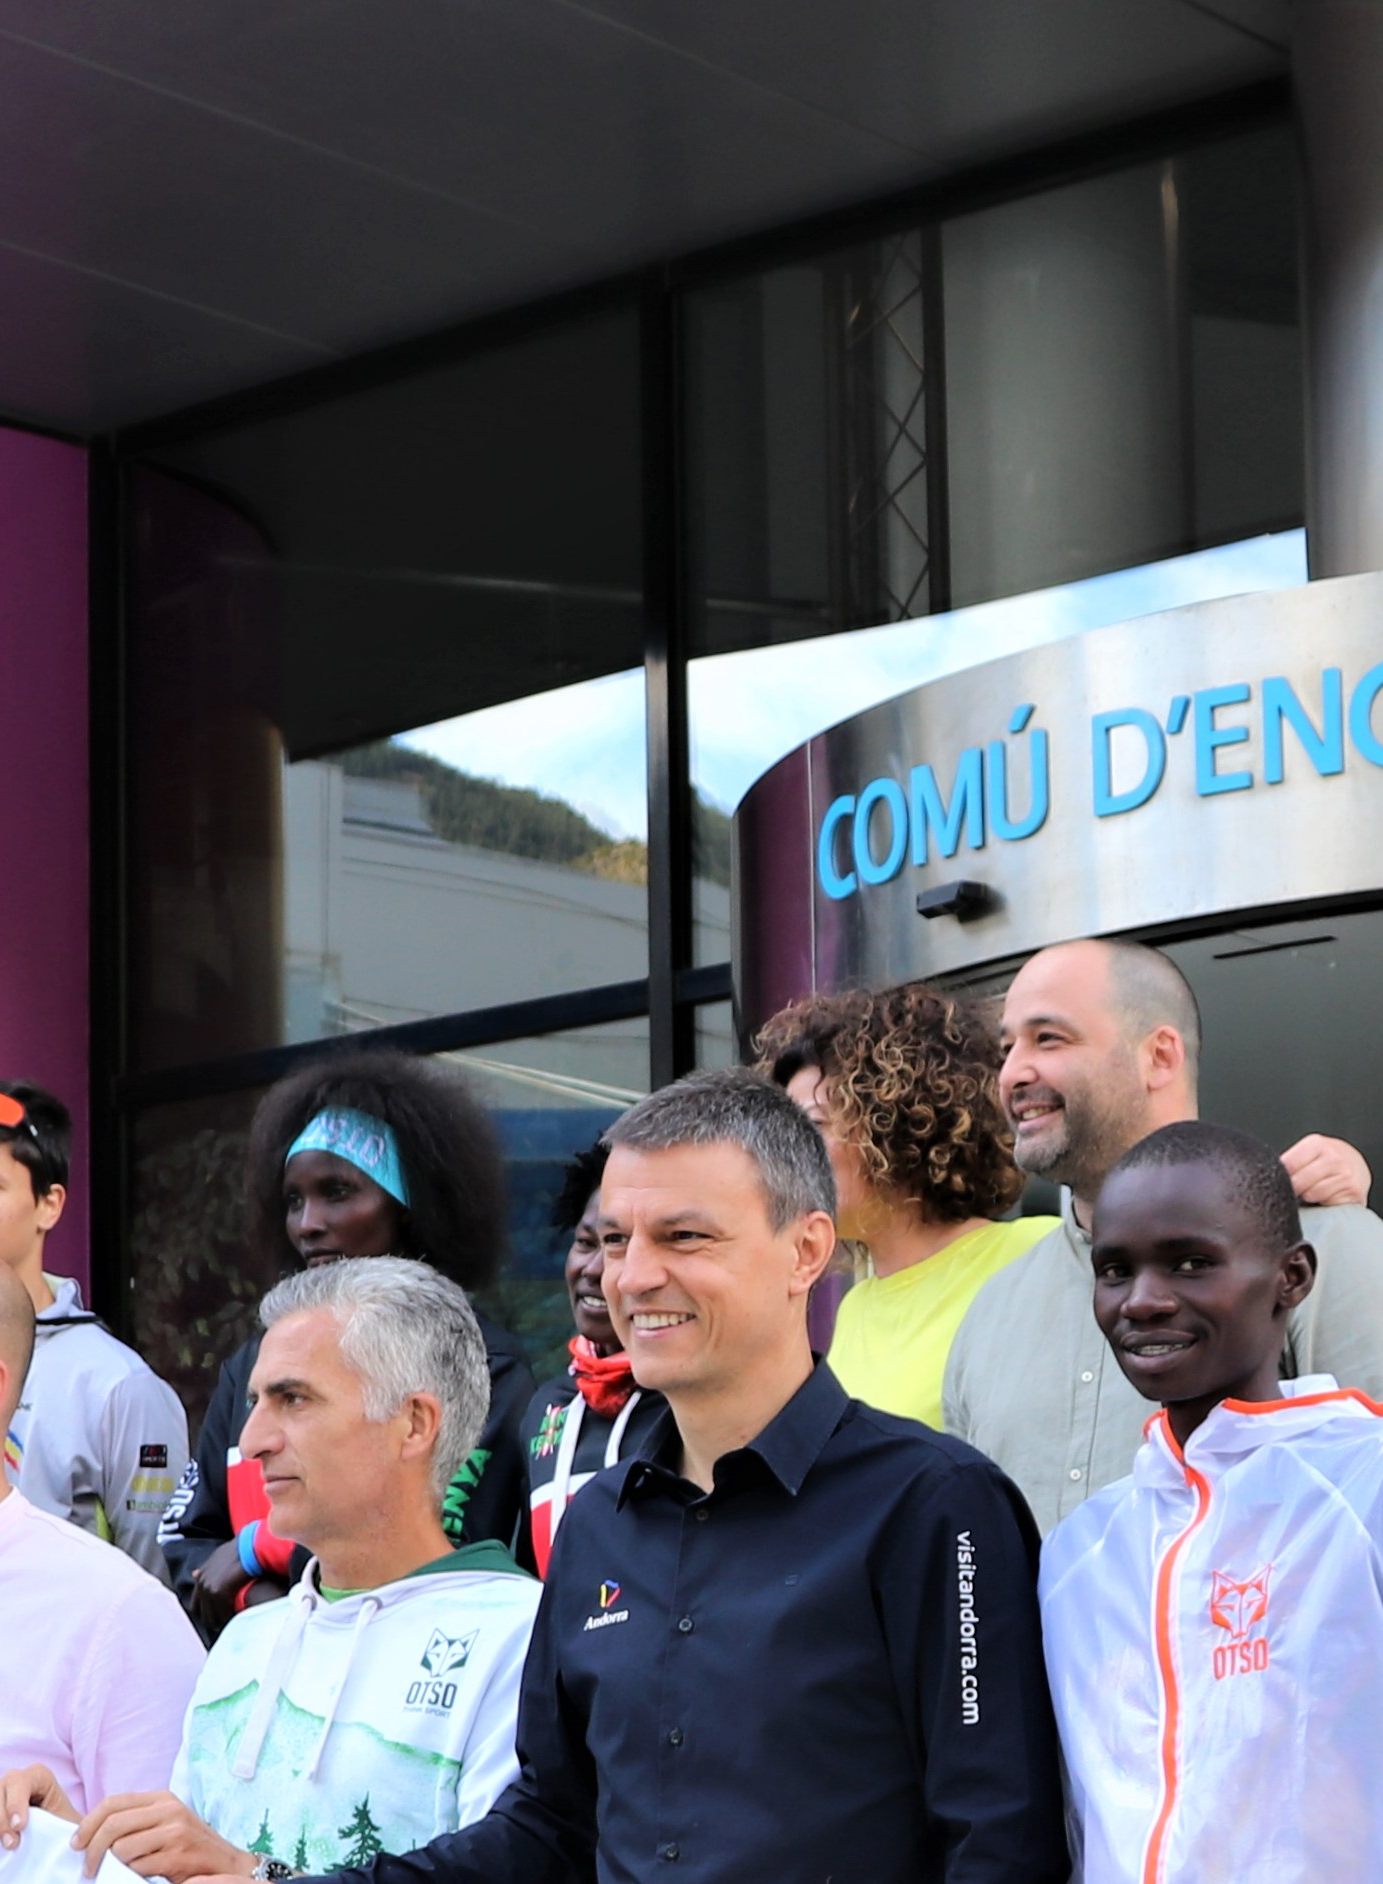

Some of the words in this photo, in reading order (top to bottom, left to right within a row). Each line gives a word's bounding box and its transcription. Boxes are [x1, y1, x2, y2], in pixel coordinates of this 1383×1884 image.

[818, 702, 1050, 901] COMÚ
[440, 1448, 492, 1543] ENYA
[583, 1609, 629, 1631] Andorra
[957, 1530, 980, 1726] visitandorra.com
[1214, 1637, 1268, 1680] OTSO
[405, 1681, 458, 1709] OTSO
